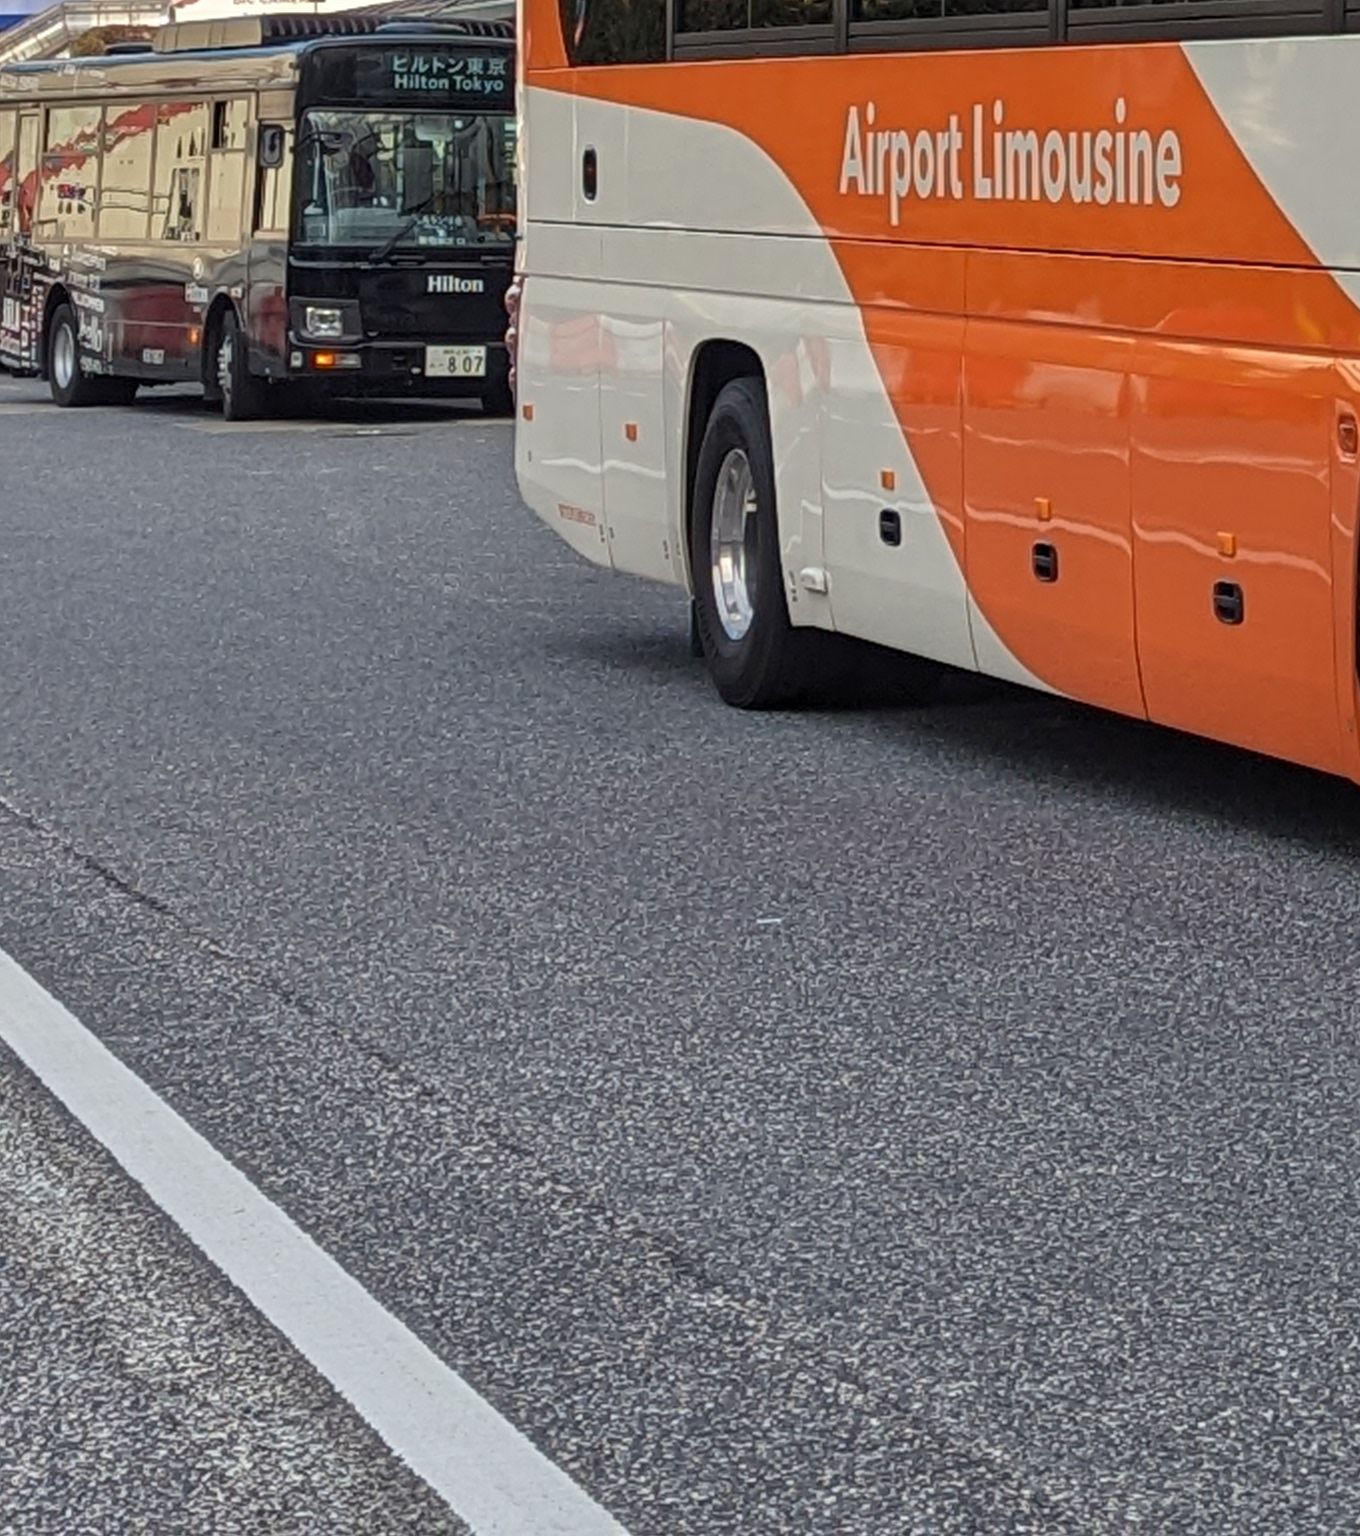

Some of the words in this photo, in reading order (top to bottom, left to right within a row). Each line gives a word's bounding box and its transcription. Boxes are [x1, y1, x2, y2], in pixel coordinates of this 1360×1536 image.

[392, 55, 507, 76] ヒルトン東京
[394, 74, 450, 92] Hilton
[453, 75, 505, 95] Tokyo
[839, 101, 964, 226] Airport
[973, 97, 1183, 207] Limousine
[427, 274, 485, 293] Hilton
